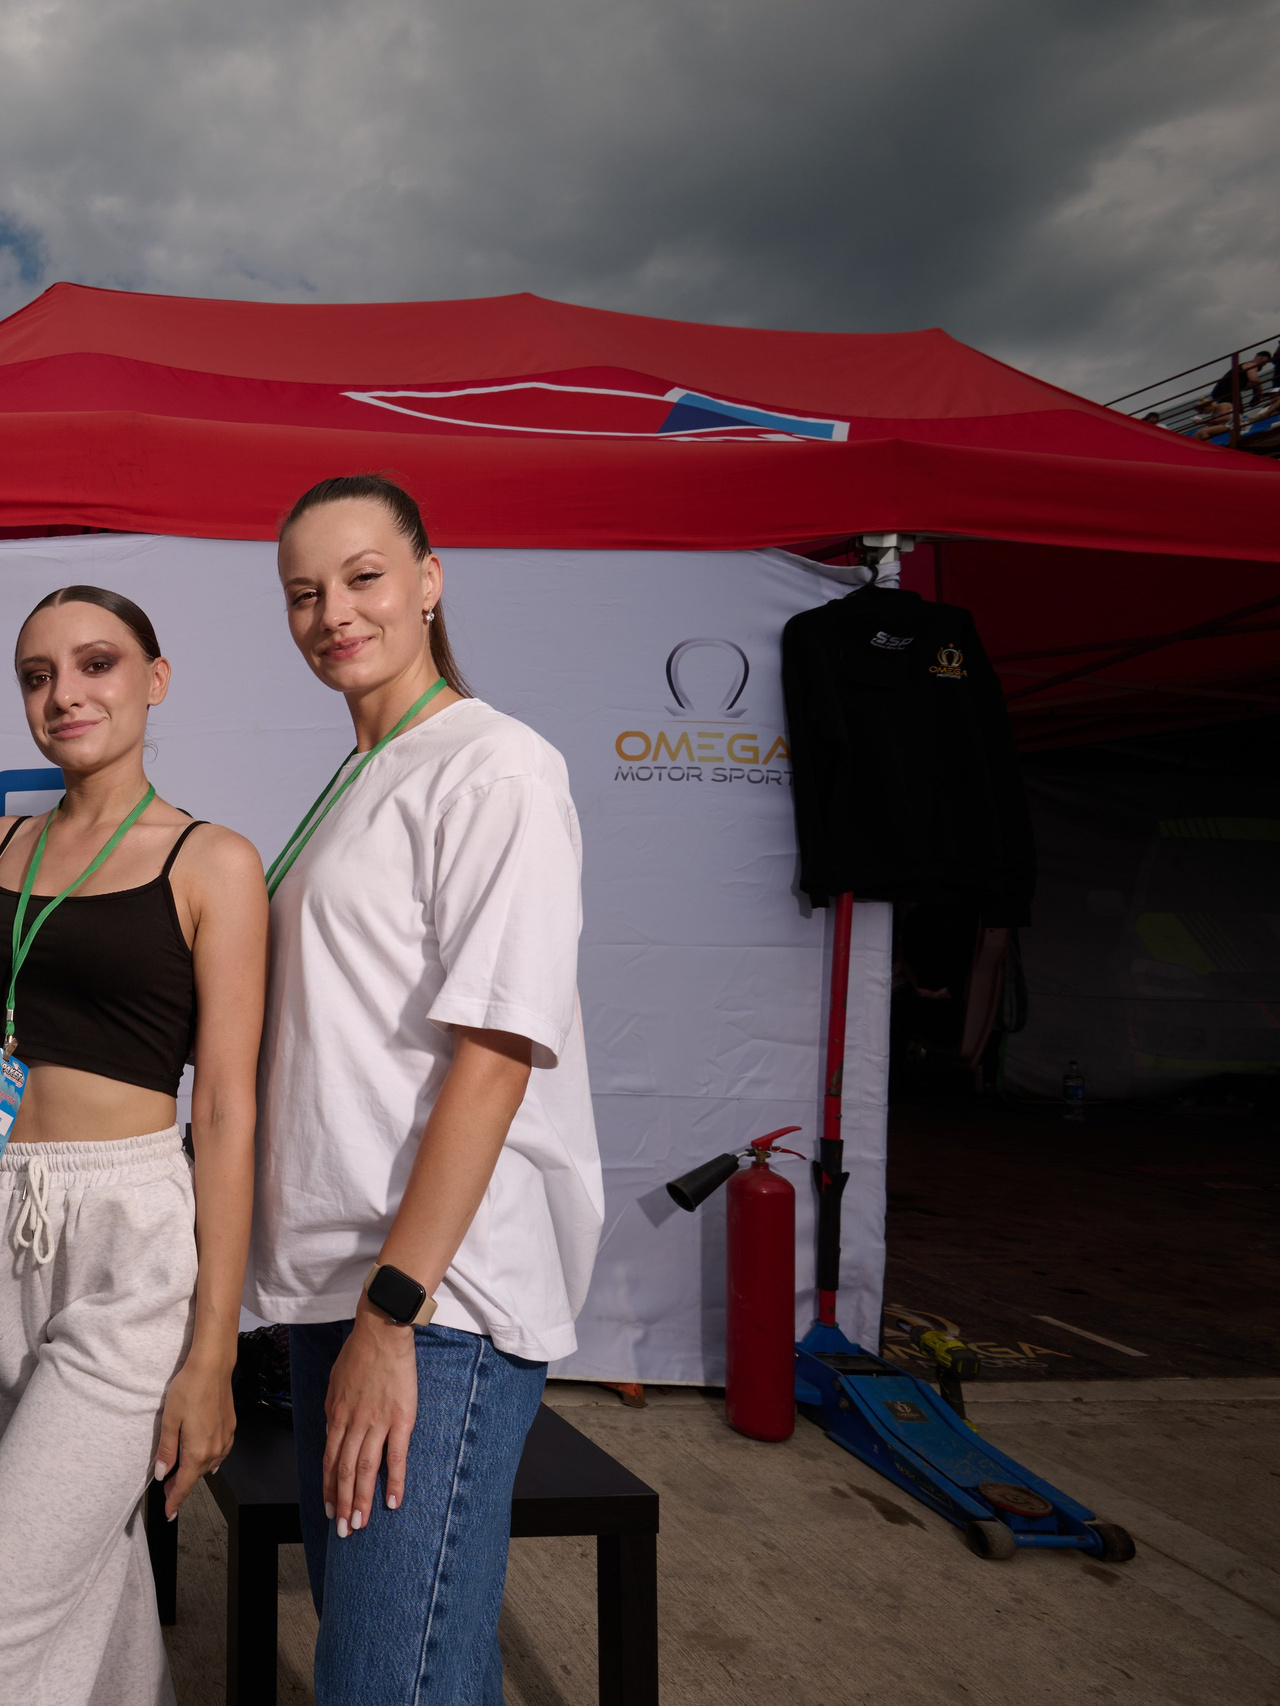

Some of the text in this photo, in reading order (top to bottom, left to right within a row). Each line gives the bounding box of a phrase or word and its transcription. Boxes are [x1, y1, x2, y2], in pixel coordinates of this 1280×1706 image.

[928, 665, 968, 677] OMEGA
[615, 730, 792, 765] OMEGA
[614, 766, 703, 782] MOTOR
